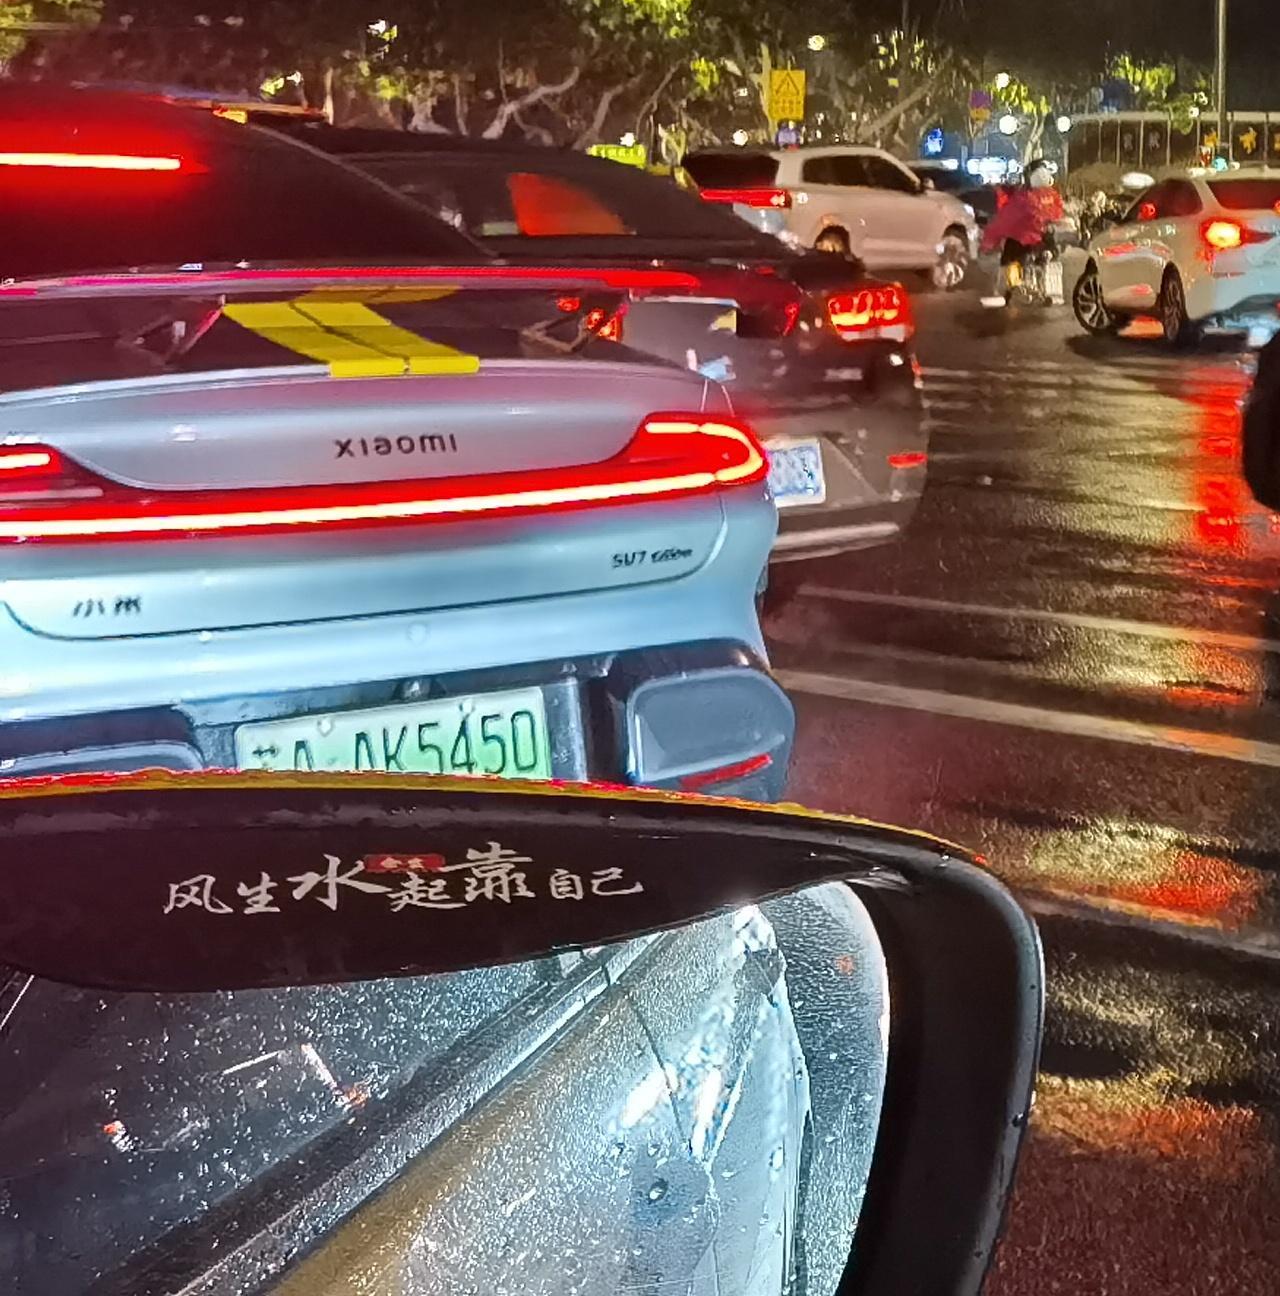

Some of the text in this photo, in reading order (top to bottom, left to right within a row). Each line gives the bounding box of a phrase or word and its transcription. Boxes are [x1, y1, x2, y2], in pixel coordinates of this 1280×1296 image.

[612, 550, 647, 568] SU7
[163, 840, 644, 914] 风生水起靠自己
